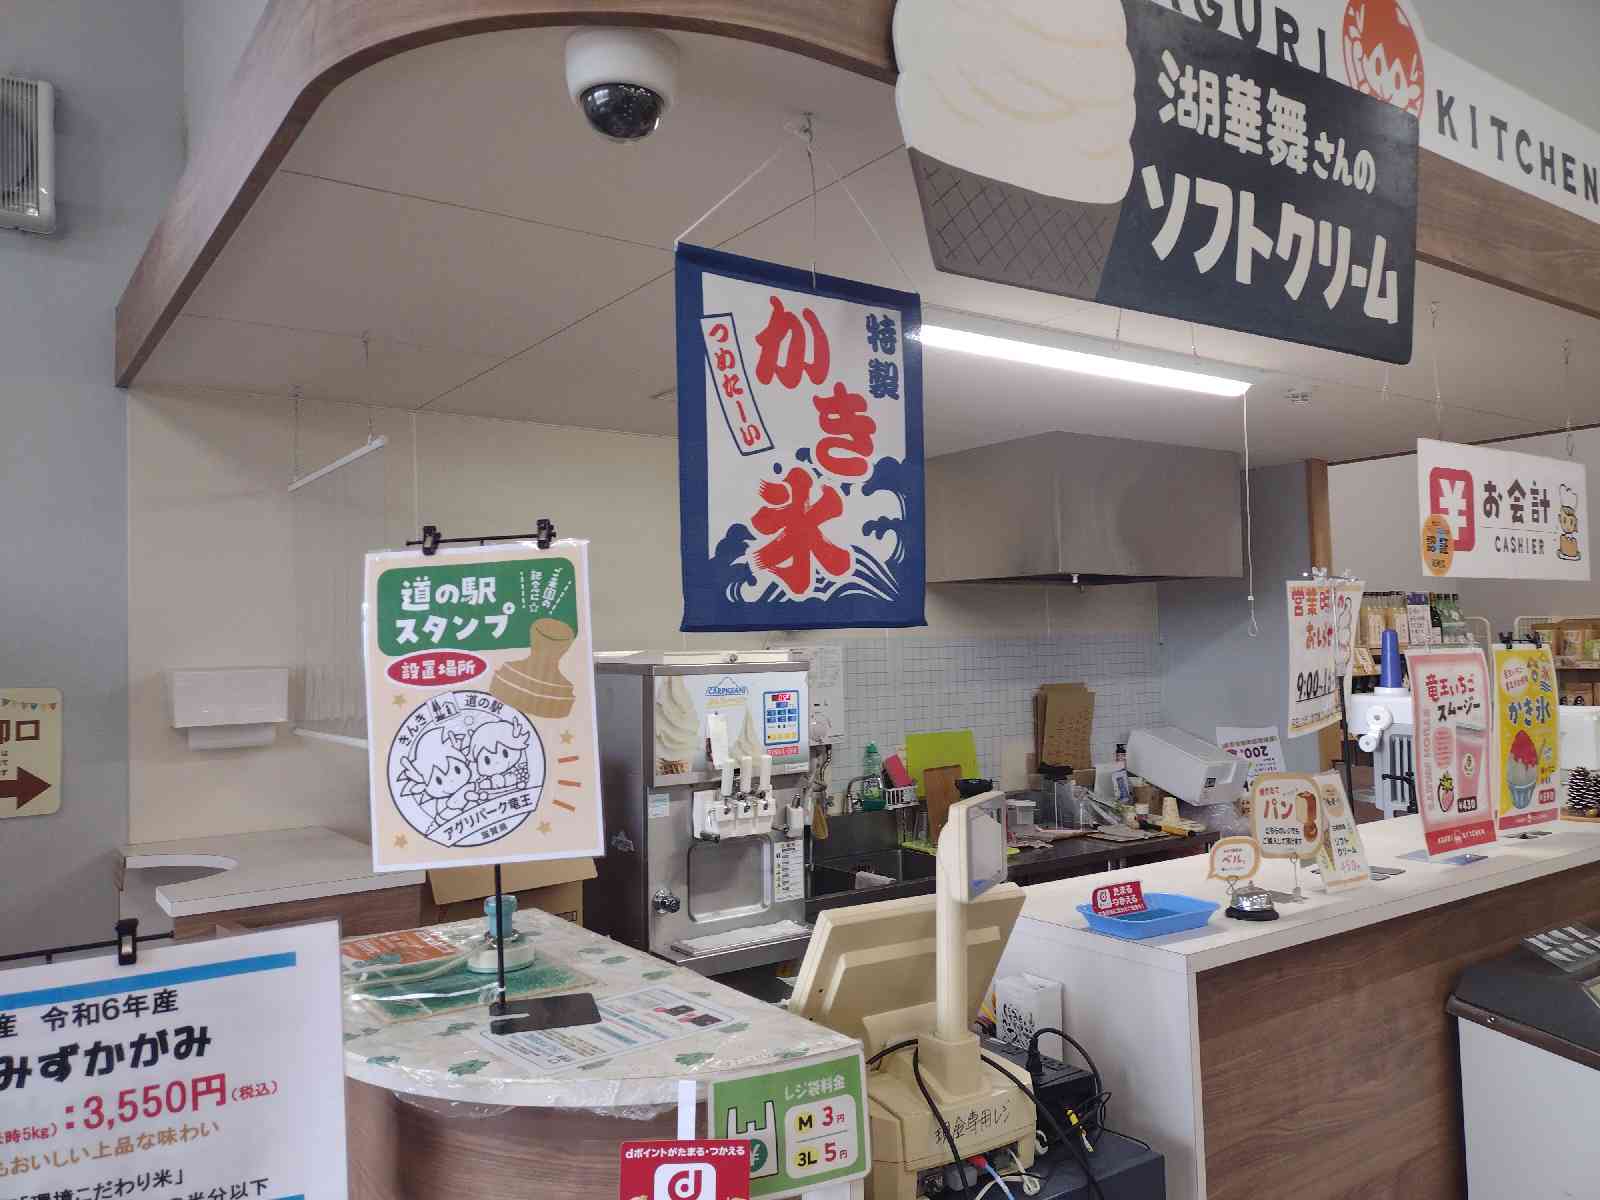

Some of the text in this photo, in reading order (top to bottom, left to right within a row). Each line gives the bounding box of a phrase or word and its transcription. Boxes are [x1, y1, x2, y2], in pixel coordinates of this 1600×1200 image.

[1158, 49, 1376, 194] 湖華舞さんの
[1437, 89, 1599, 205] KITCHEN
[1141, 165, 1397, 324] ソフトクリーム
[865, 313, 900, 400] 特製
[751, 296, 877, 595] かき氷
[1483, 479, 1551, 524] お会計
[1495, 537, 1546, 554] CASHIER
[400, 576, 496, 611] 道の駅
[395, 602, 516, 643] スタンプ
[401, 661, 475, 680] 設置場所
[1437, 696, 1481, 722] スムージー
[1509, 696, 1551, 725] かき氷
[398, 713, 427, 746] きんき
[1263, 798, 1294, 820] パン
[41, 988, 179, 1032] 令和6年産
[0, 1026, 211, 1092] みずかがみ
[784, 1075, 845, 1100] レジ袋料金
[798, 1115, 813, 1131] M
[797, 1151, 817, 1167] 3L
